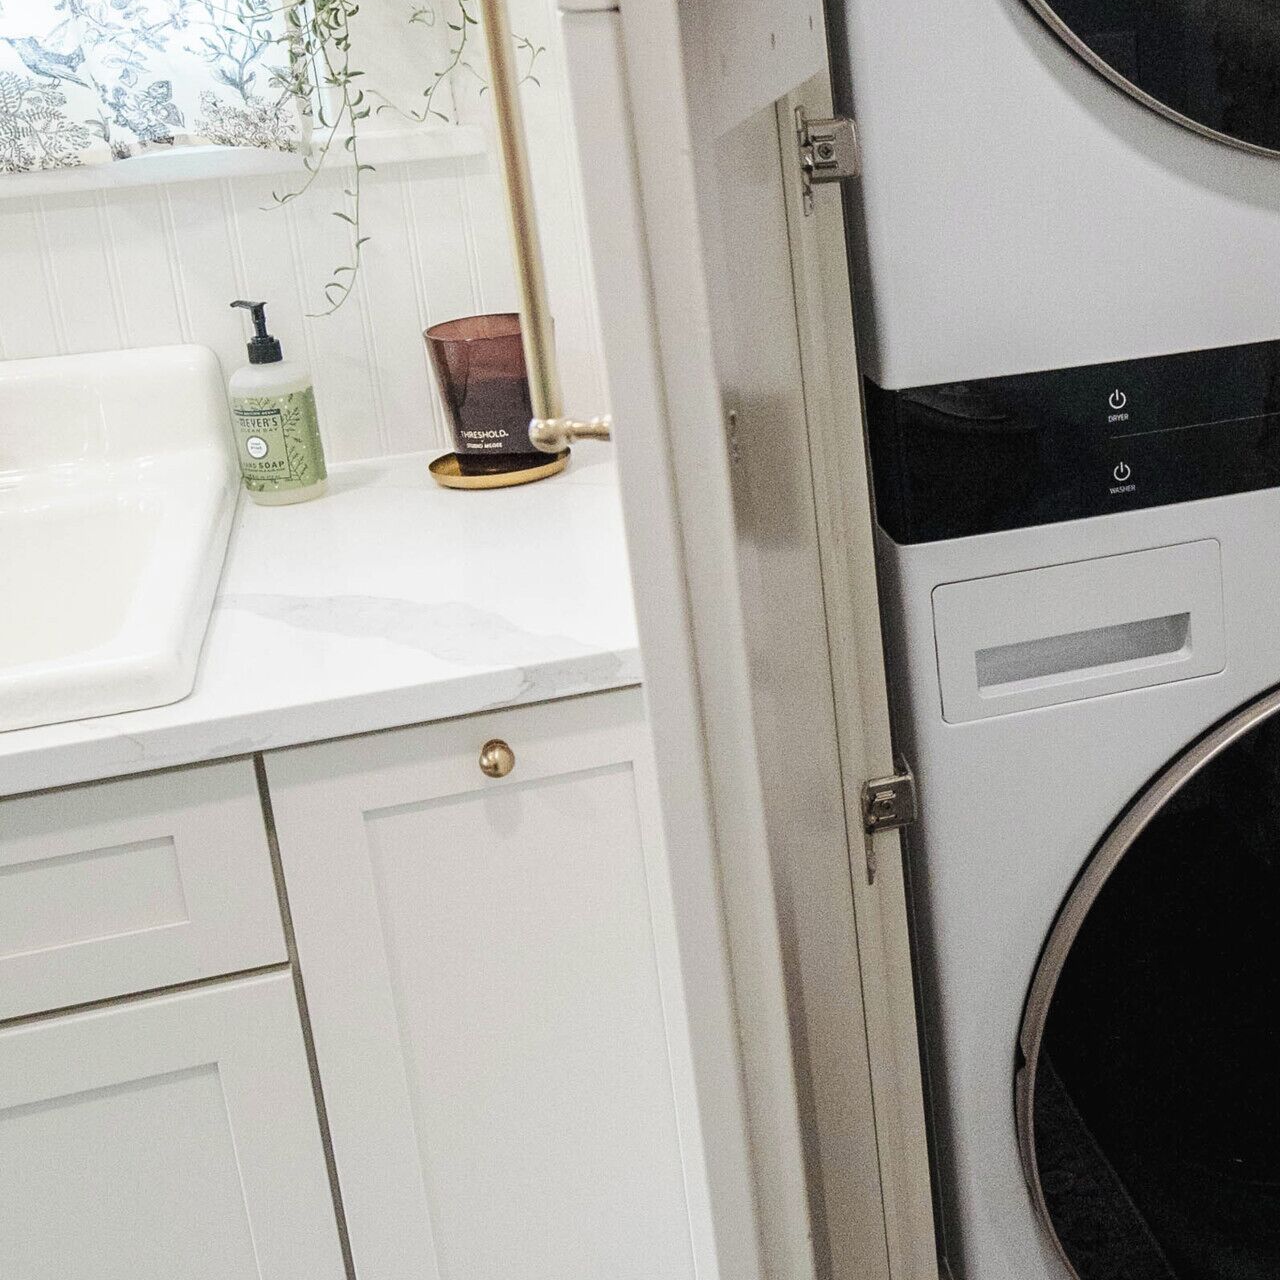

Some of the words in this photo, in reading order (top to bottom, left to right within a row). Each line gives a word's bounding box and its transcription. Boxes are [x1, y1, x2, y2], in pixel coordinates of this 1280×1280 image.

[239, 417, 278, 428] MEYER'S
[1108, 413, 1129, 423] DRYER
[258, 461, 285, 469] SOAP
[1109, 484, 1136, 495] WASHER
